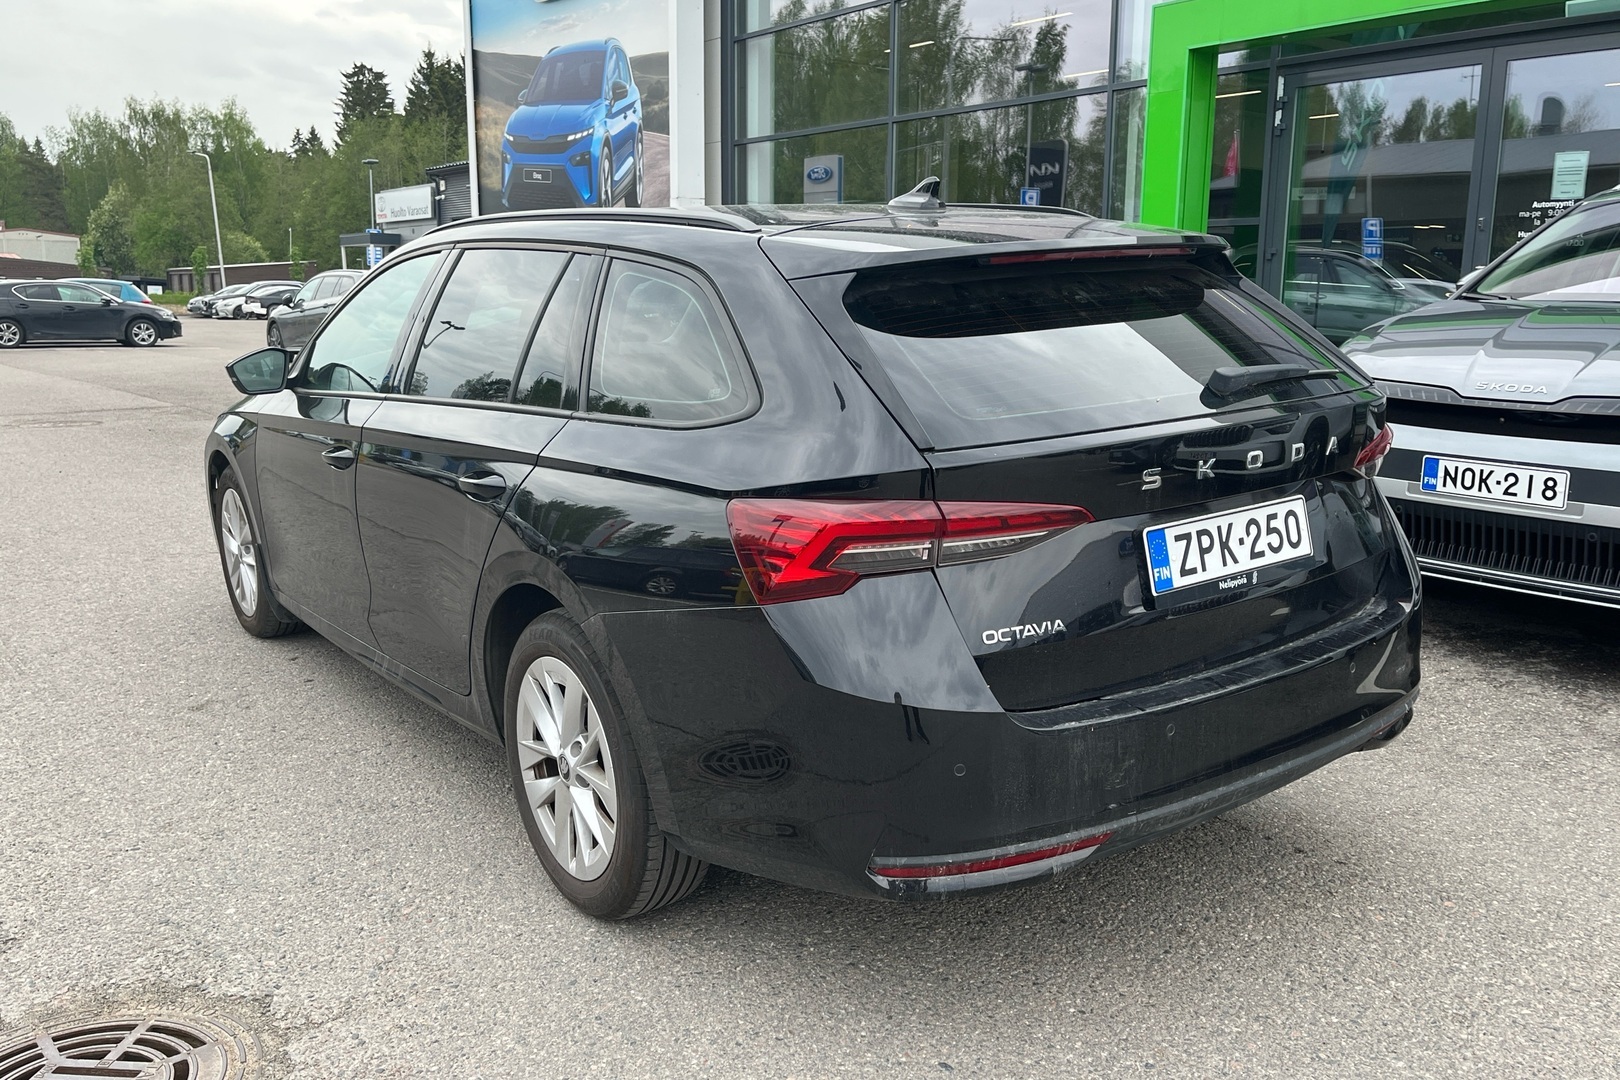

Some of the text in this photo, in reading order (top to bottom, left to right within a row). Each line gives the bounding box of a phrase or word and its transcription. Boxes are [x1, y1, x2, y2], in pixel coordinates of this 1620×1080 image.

[1532, 200, 1575, 209] Automyynti
[1475, 381, 1548, 394] SKODA
[1141, 436, 1340, 491] SKODA
[1424, 464, 1558, 501] FIN NOK-218
[1153, 509, 1302, 582] FIN ZPK-250
[982, 619, 1067, 645] OCTAVIA
